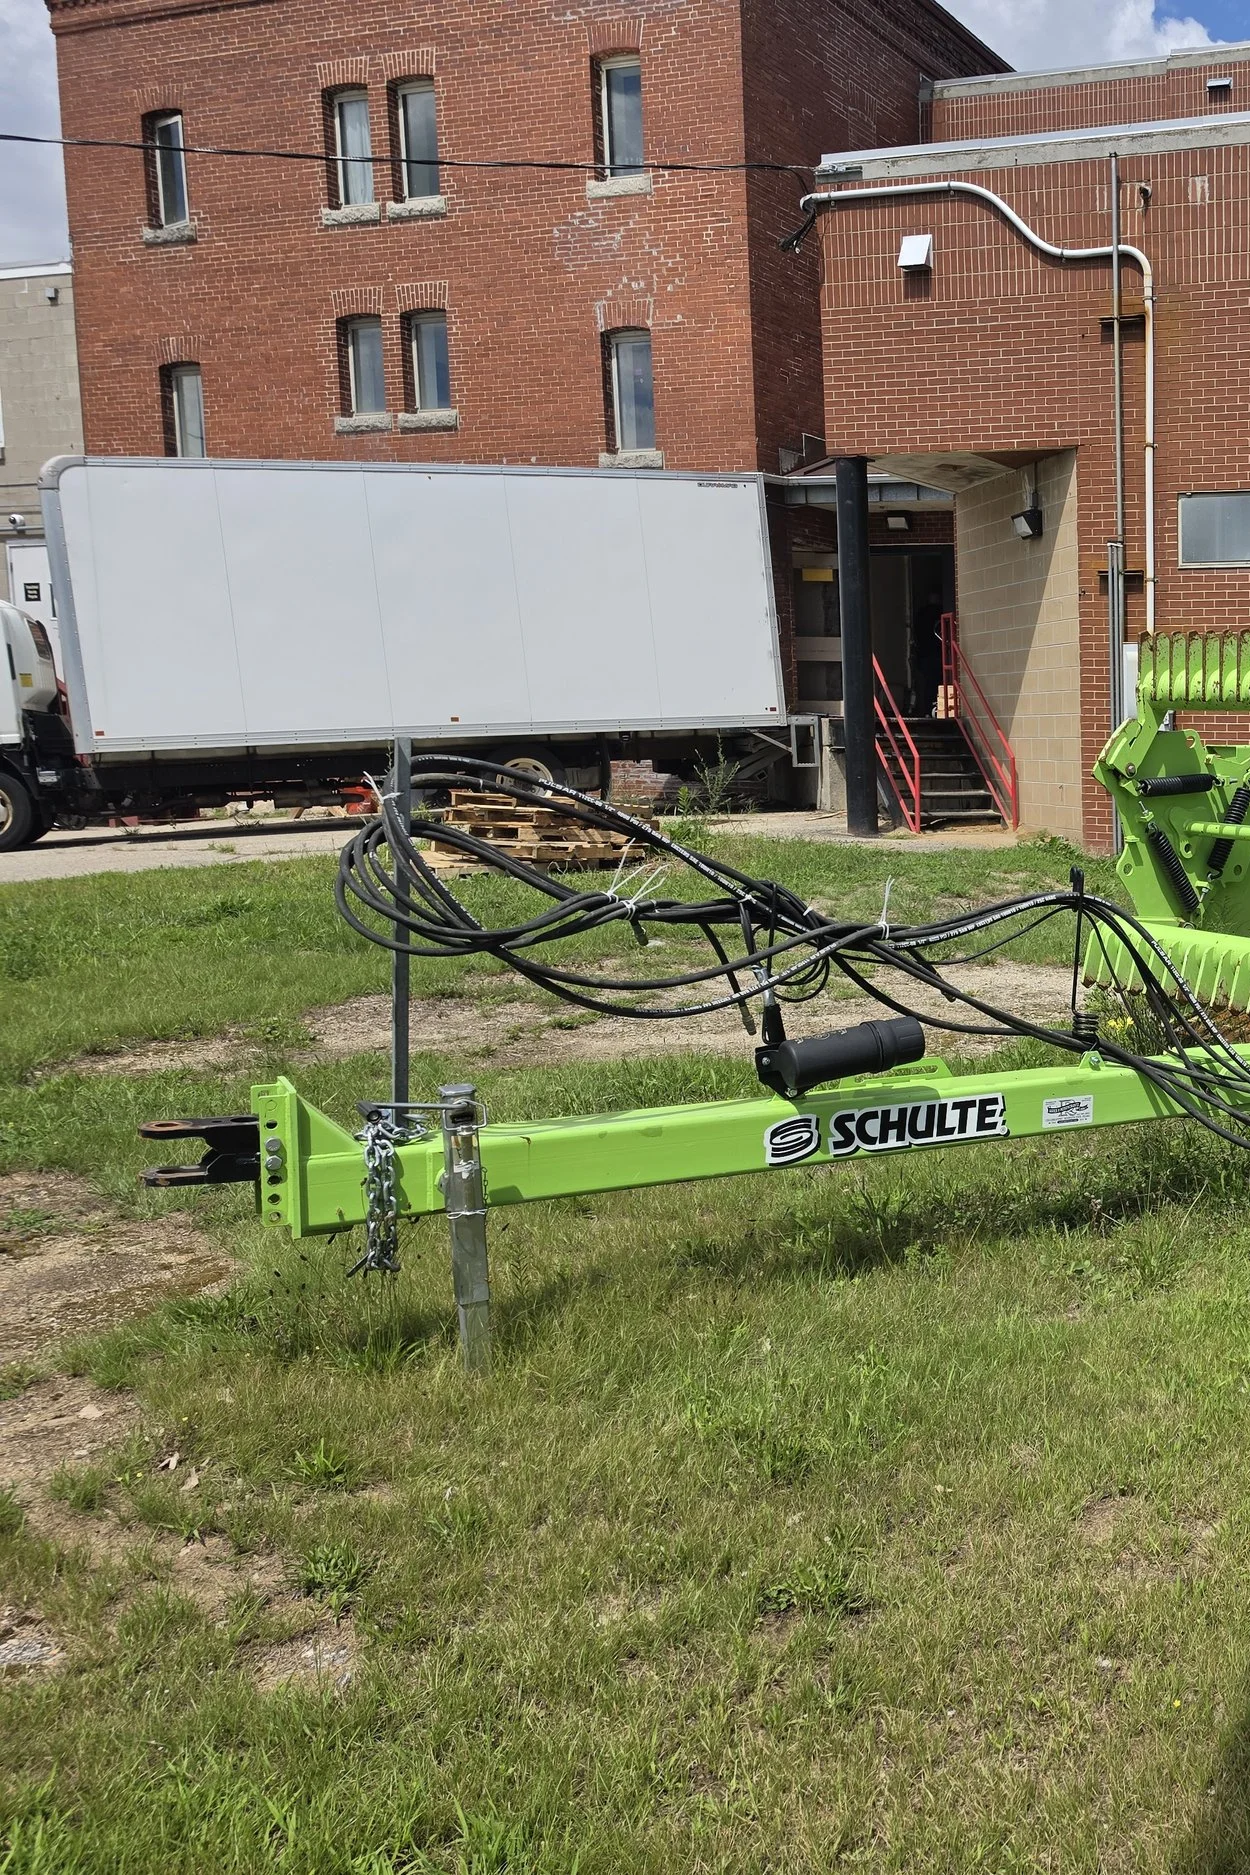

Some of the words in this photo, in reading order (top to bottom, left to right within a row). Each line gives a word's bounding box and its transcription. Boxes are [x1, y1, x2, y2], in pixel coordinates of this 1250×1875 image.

[538, 776, 577, 794] PULSAR
[1151, 939, 1171, 965] PULSAR
[832, 1096, 999, 1149] SCHULTE
